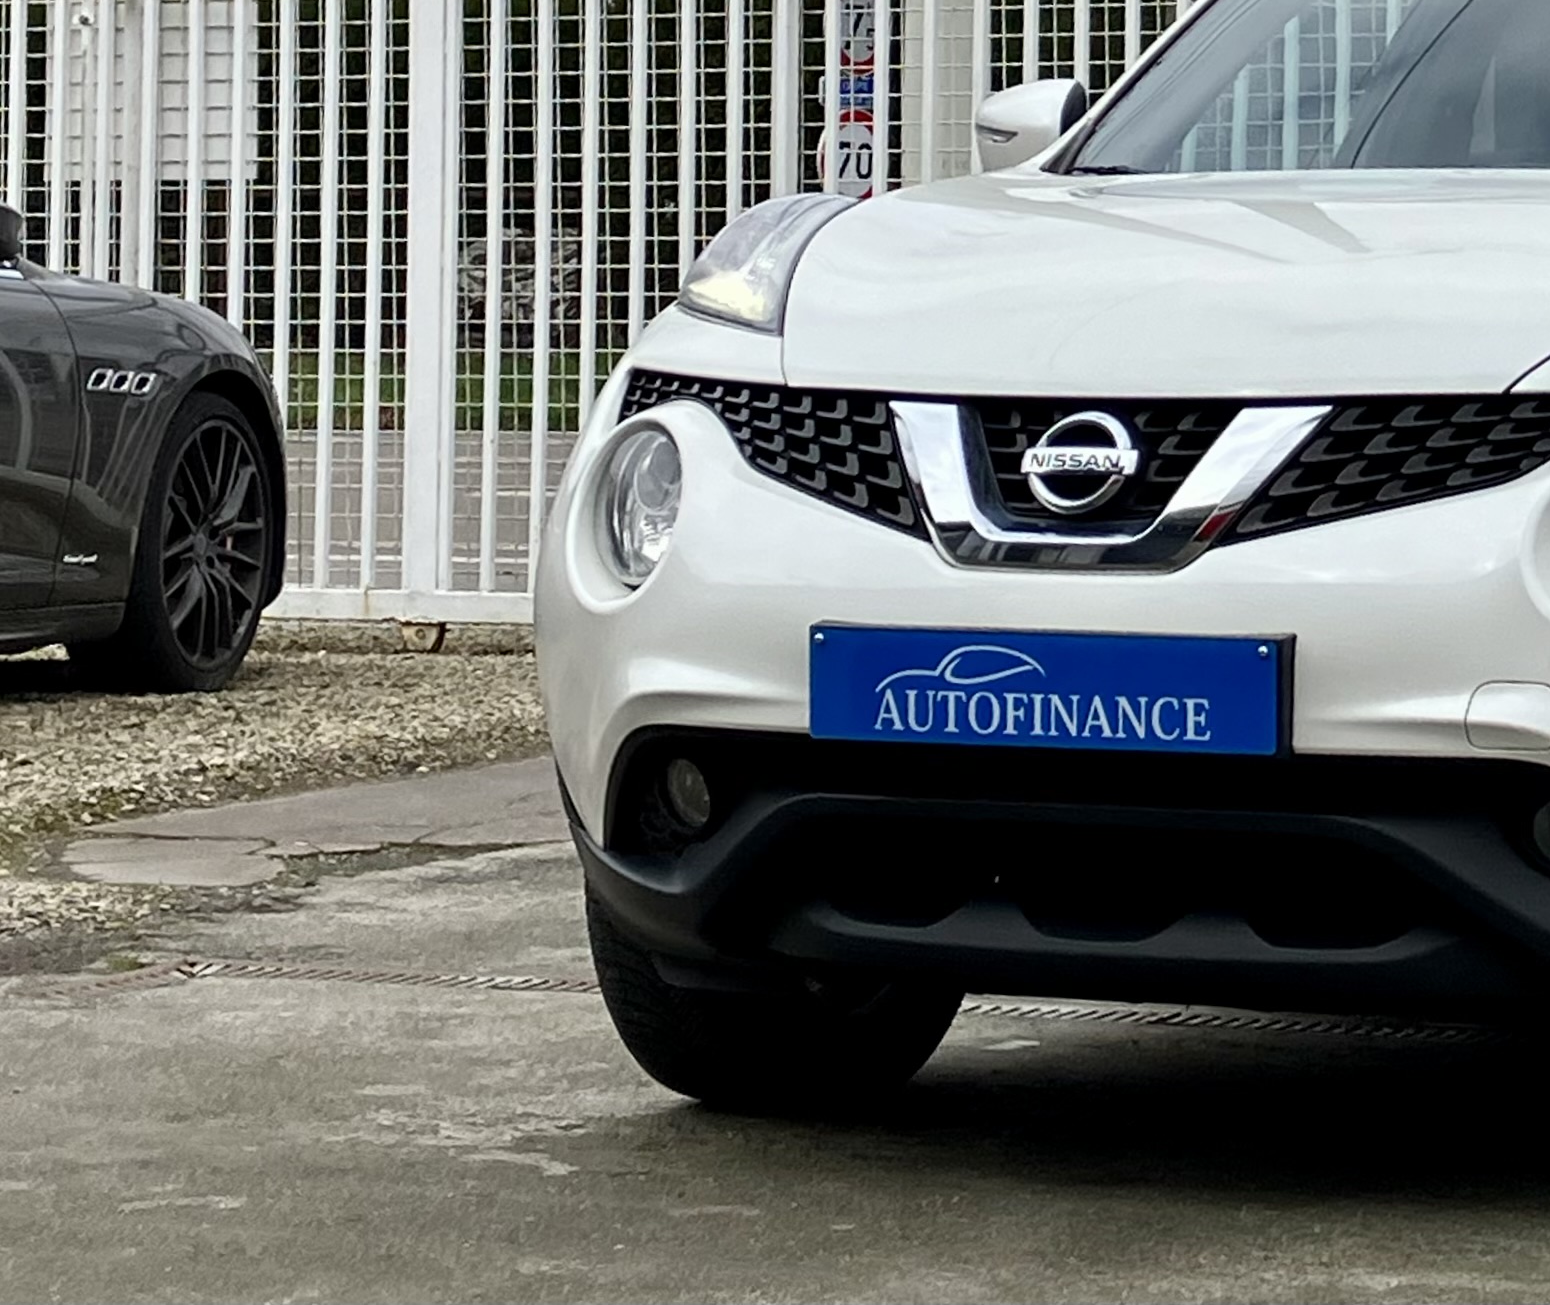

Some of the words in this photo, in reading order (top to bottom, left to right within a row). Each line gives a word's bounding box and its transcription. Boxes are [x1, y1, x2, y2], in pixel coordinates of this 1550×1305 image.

[838, 141, 873, 180] 70
[1030, 453, 1121, 469] NISSAN
[874, 688, 1212, 742] AUTOFINANCE
